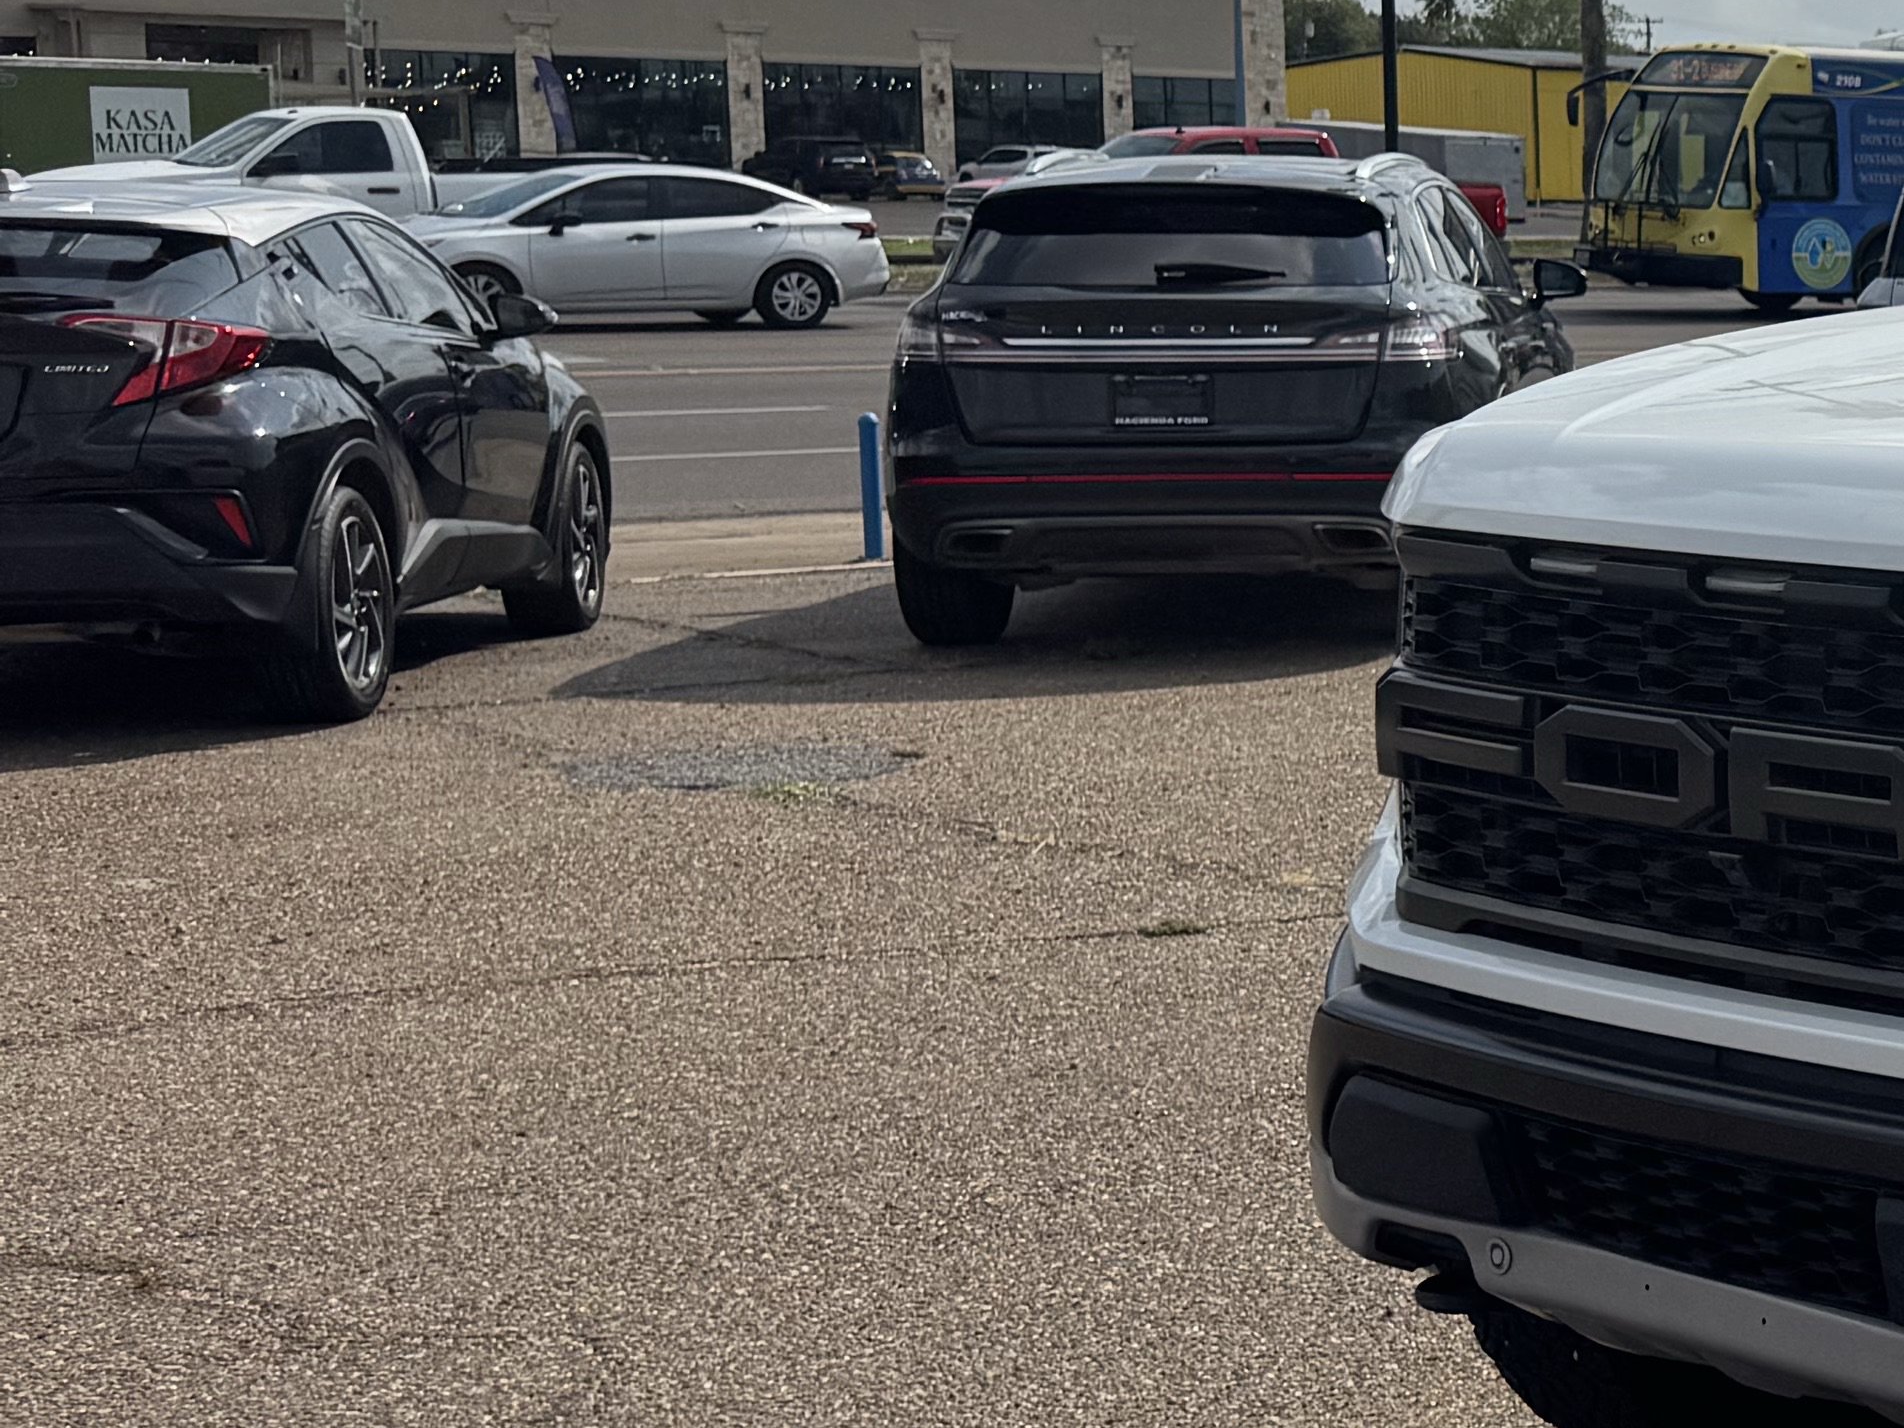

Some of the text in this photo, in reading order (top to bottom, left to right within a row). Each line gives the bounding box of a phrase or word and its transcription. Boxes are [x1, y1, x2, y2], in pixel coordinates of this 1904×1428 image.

[105, 109, 177, 131] KASA
[95, 132, 189, 154] MATCHA
[1041, 324, 1278, 334] LINCOLN
[44, 365, 109, 373] LIMITED
[1115, 416, 1209, 425] HACIENDA FORD
